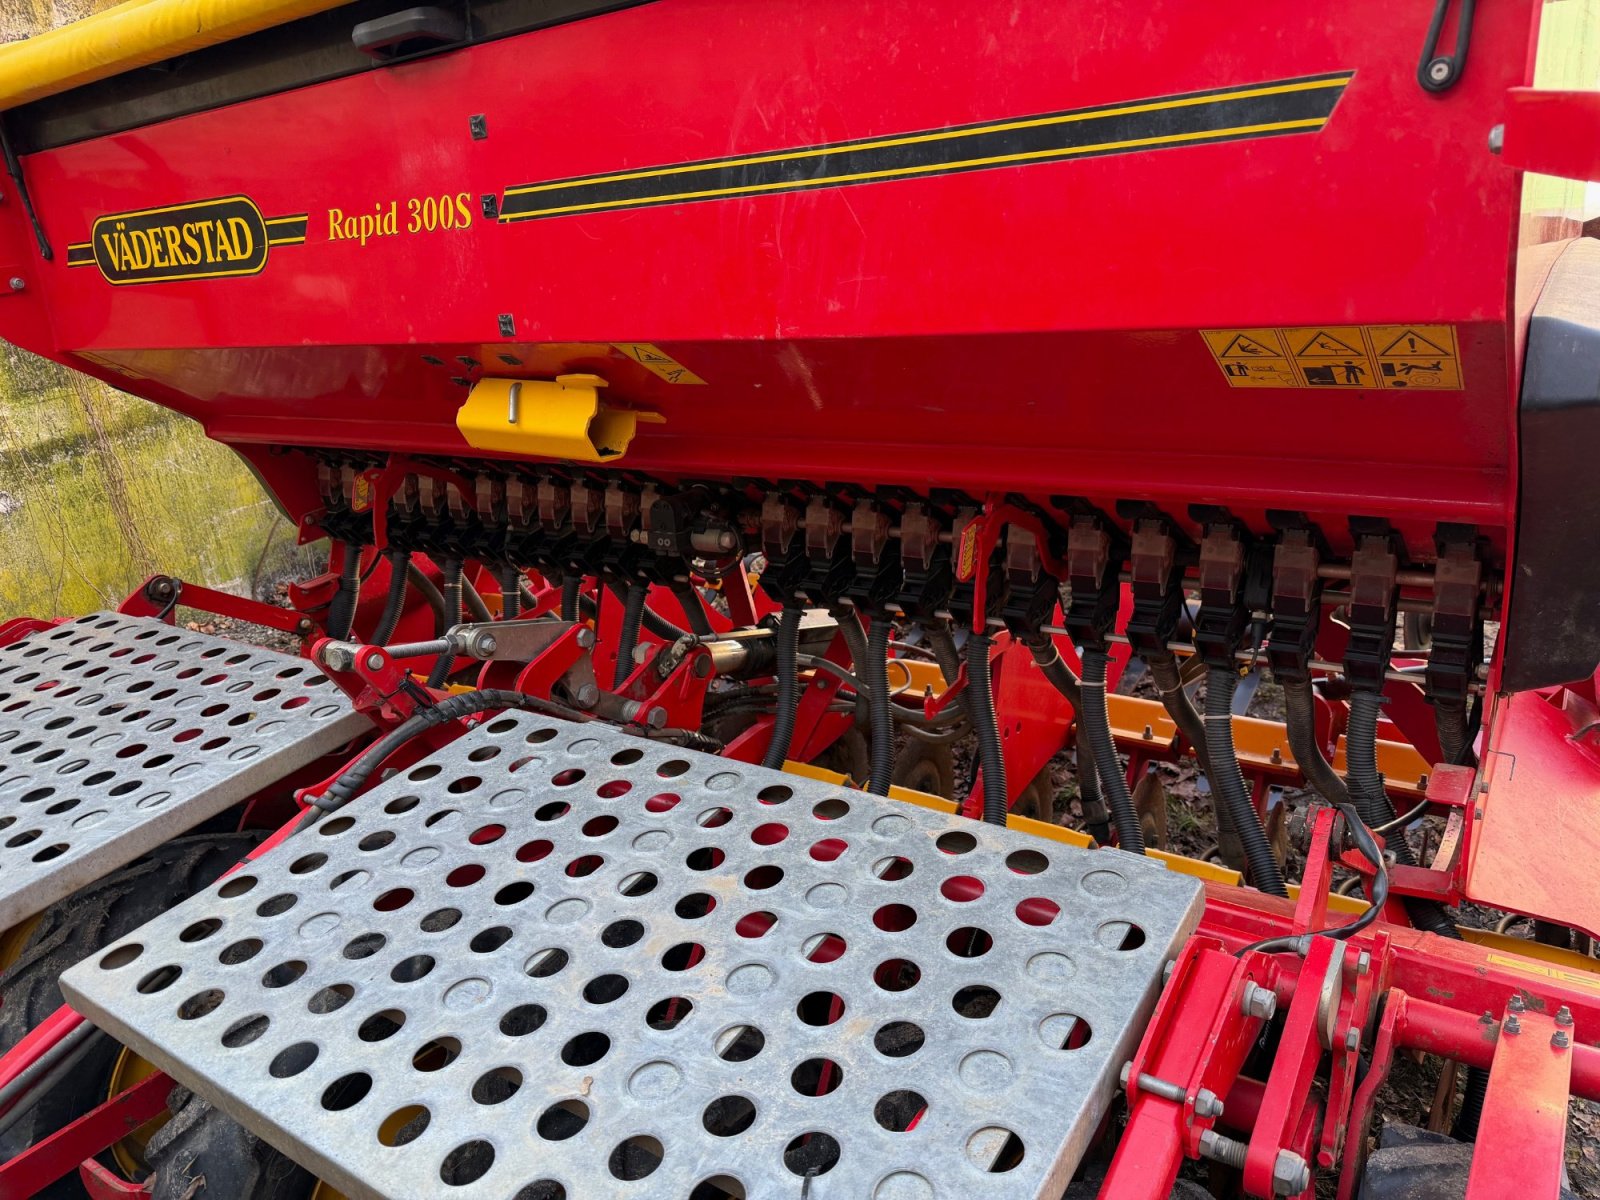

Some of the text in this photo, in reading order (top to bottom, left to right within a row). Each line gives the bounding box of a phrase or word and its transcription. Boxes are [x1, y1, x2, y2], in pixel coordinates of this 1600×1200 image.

[101, 217, 253, 271] VÄDERSTAD
[327, 192, 472, 247] Rapid 300S
